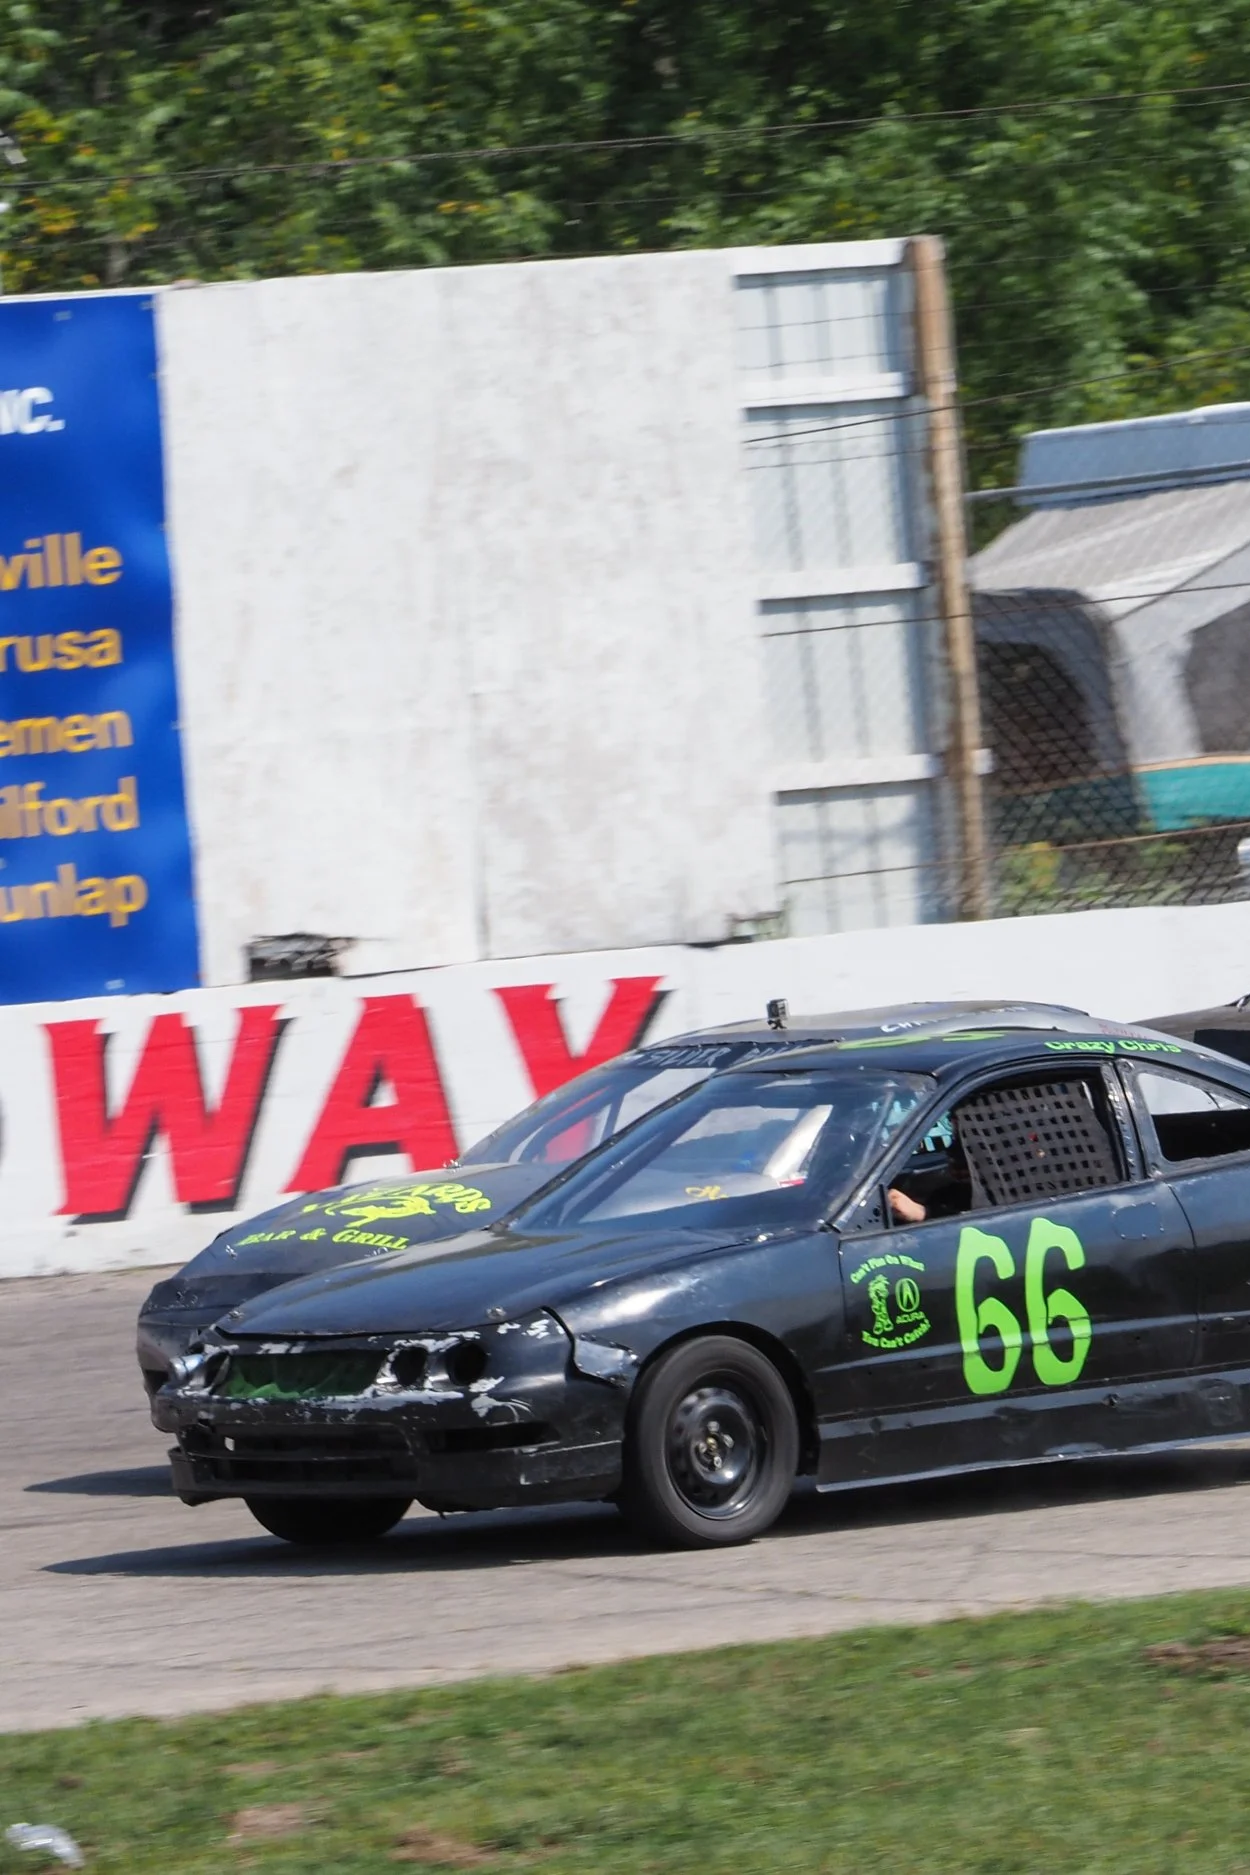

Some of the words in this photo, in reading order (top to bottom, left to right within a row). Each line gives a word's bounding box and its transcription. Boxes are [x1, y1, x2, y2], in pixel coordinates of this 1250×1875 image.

[299, 1227, 327, 1241] &
[331, 1227, 410, 1250] GRILL
[955, 1216, 1092, 1395] 66
